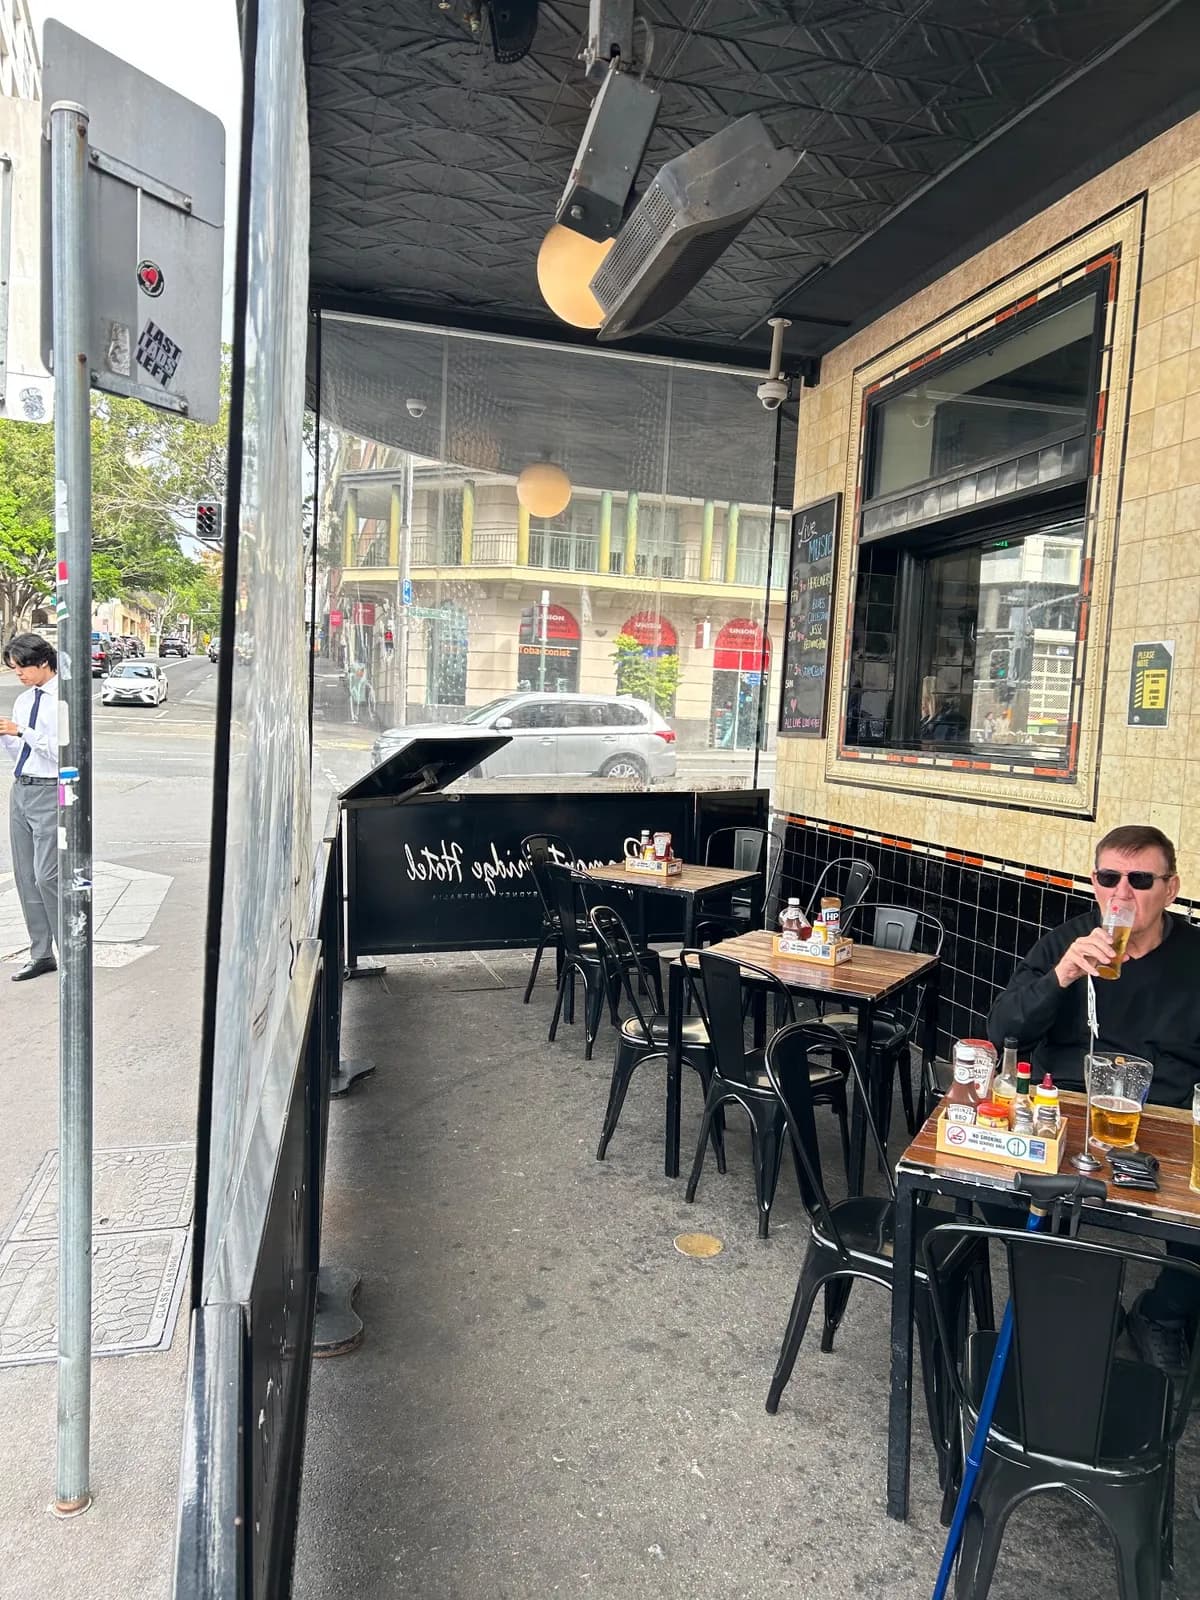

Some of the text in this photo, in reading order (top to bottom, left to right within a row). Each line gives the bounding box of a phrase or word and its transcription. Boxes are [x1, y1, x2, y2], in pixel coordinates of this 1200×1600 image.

[146, 321, 182, 360] LAST
[136, 348, 171, 386] LEFT
[798, 516, 817, 548] Live
[808, 531, 833, 562] MUSIC
[826, 912, 839, 921] HP
[980, 1134, 1002, 1143] SMOKING
